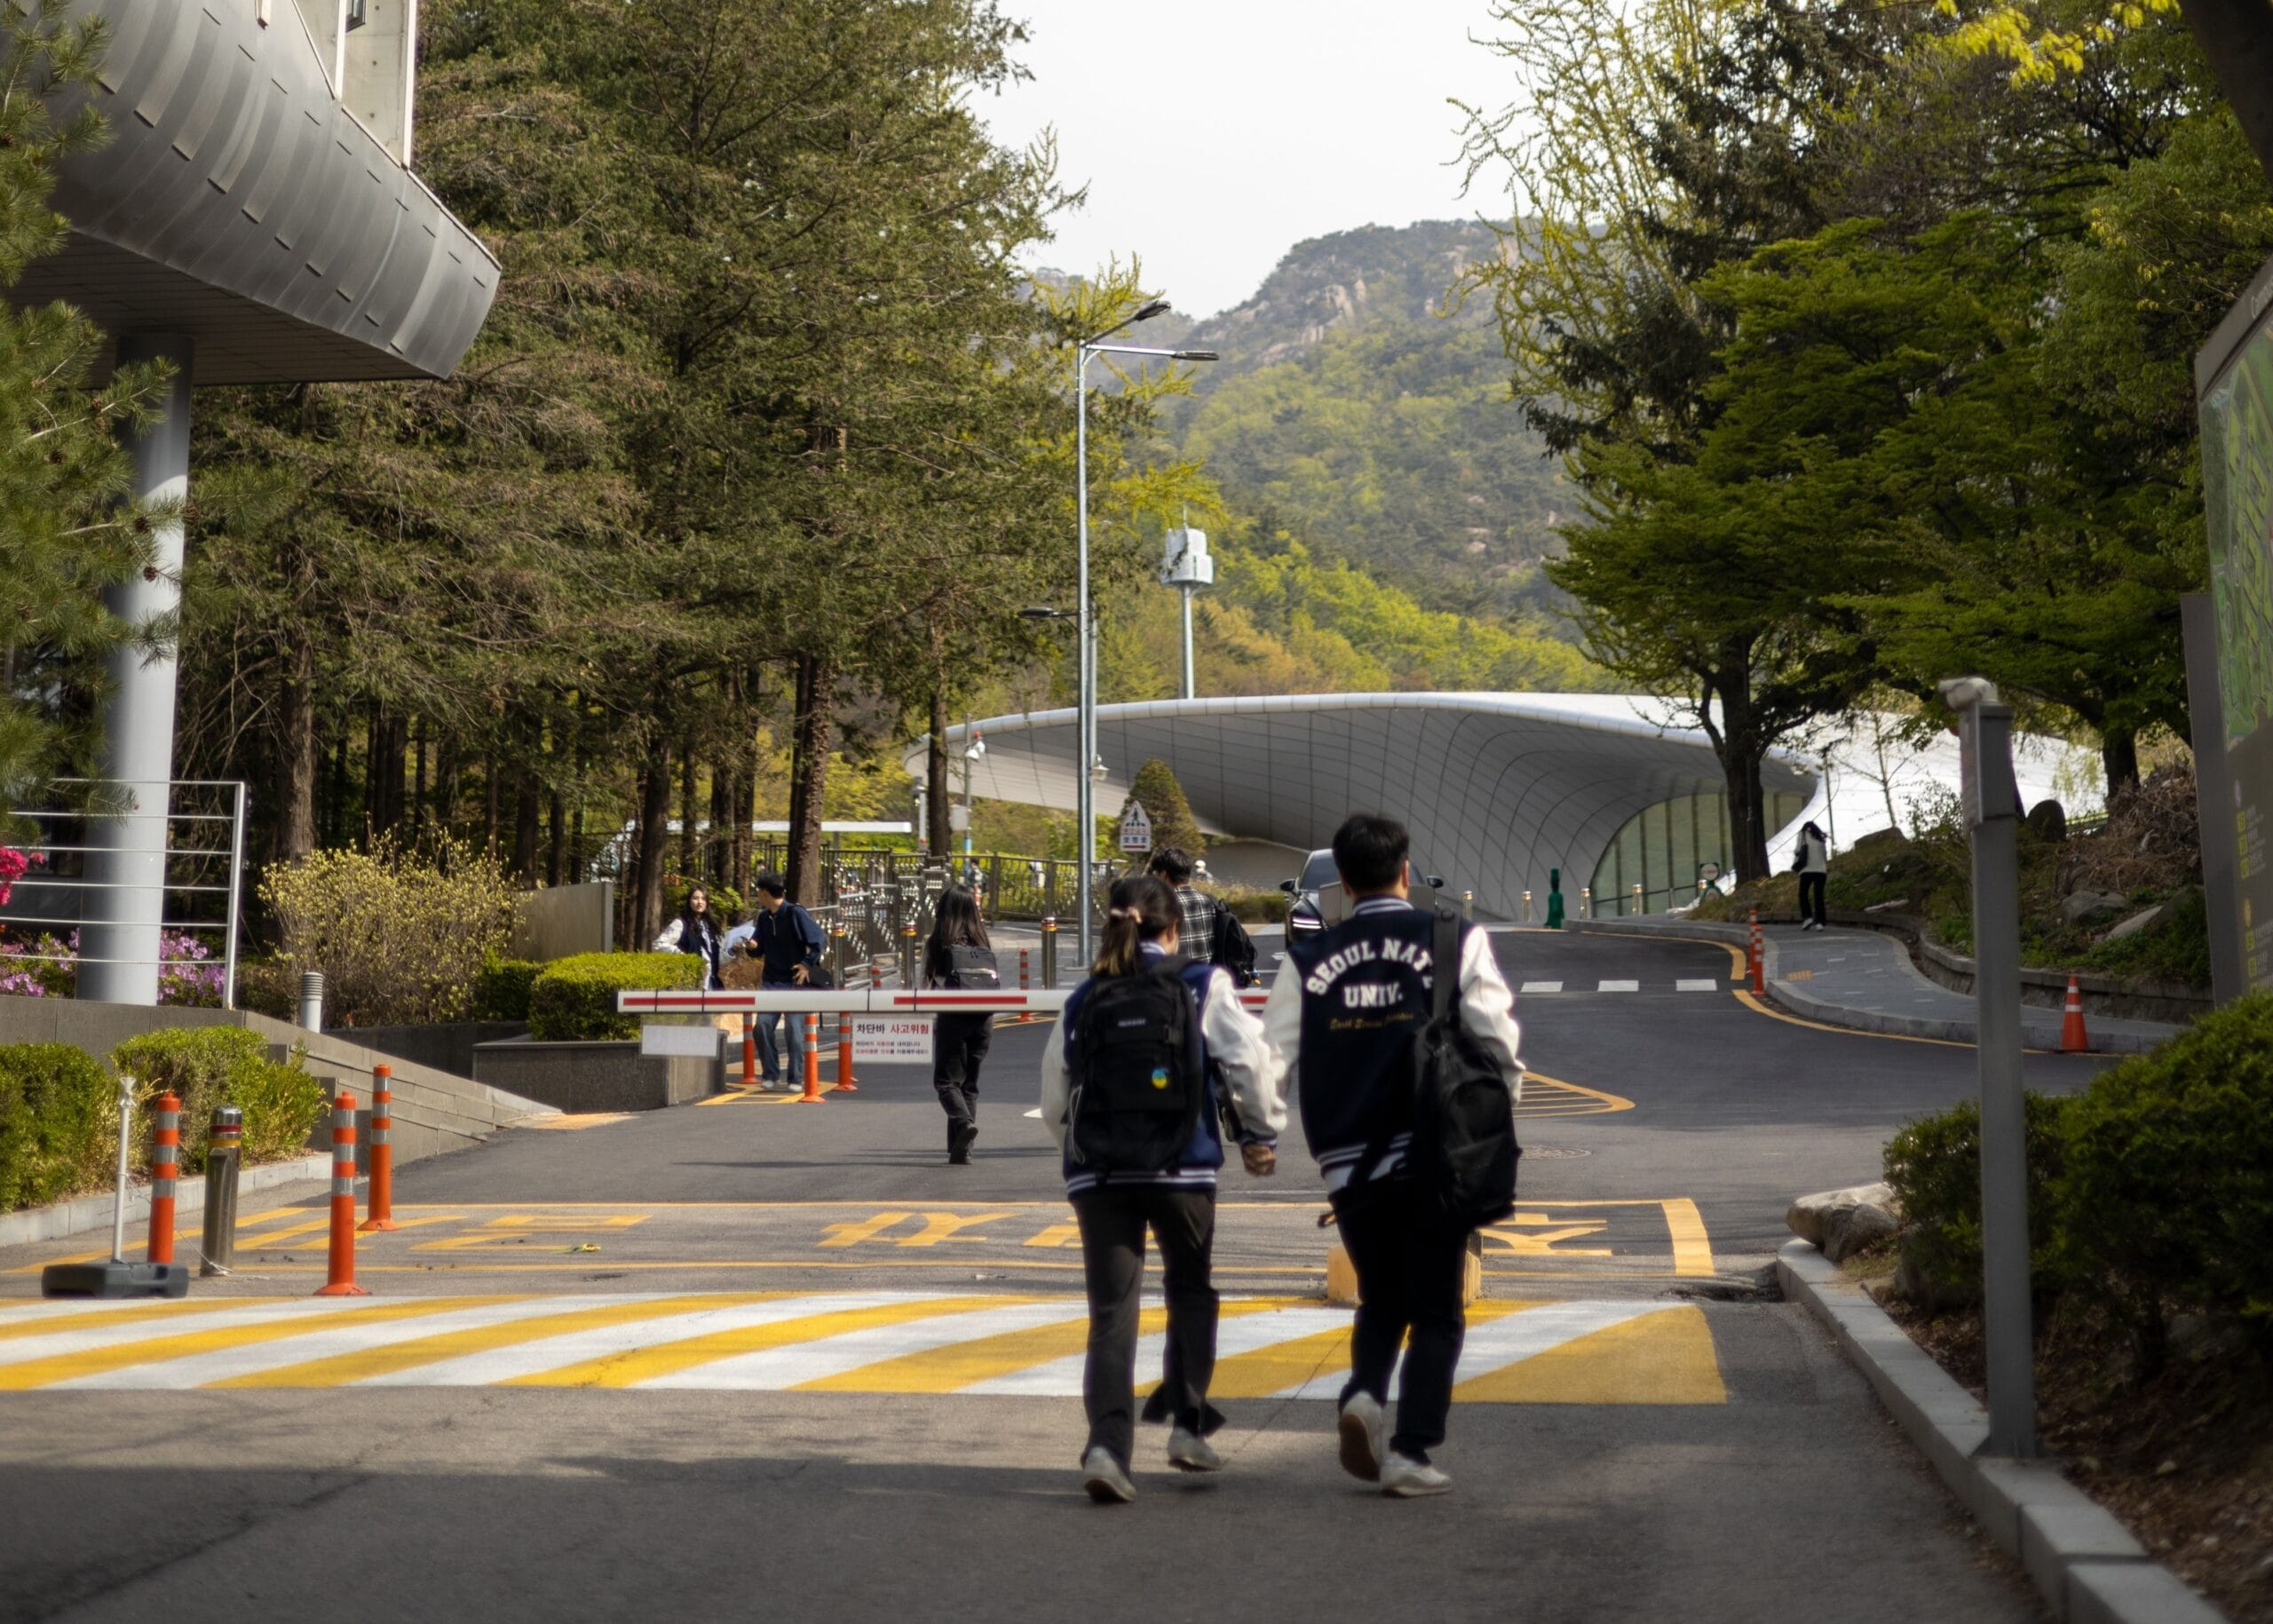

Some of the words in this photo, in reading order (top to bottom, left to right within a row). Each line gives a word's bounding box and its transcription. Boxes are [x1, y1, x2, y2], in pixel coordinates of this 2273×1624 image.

[1306, 939, 1376, 995] SEOUL
[1342, 982, 1405, 1008] UNIV.
[856, 1023, 885, 1034] 차단바
[890, 1023, 929, 1034] 사고위험
